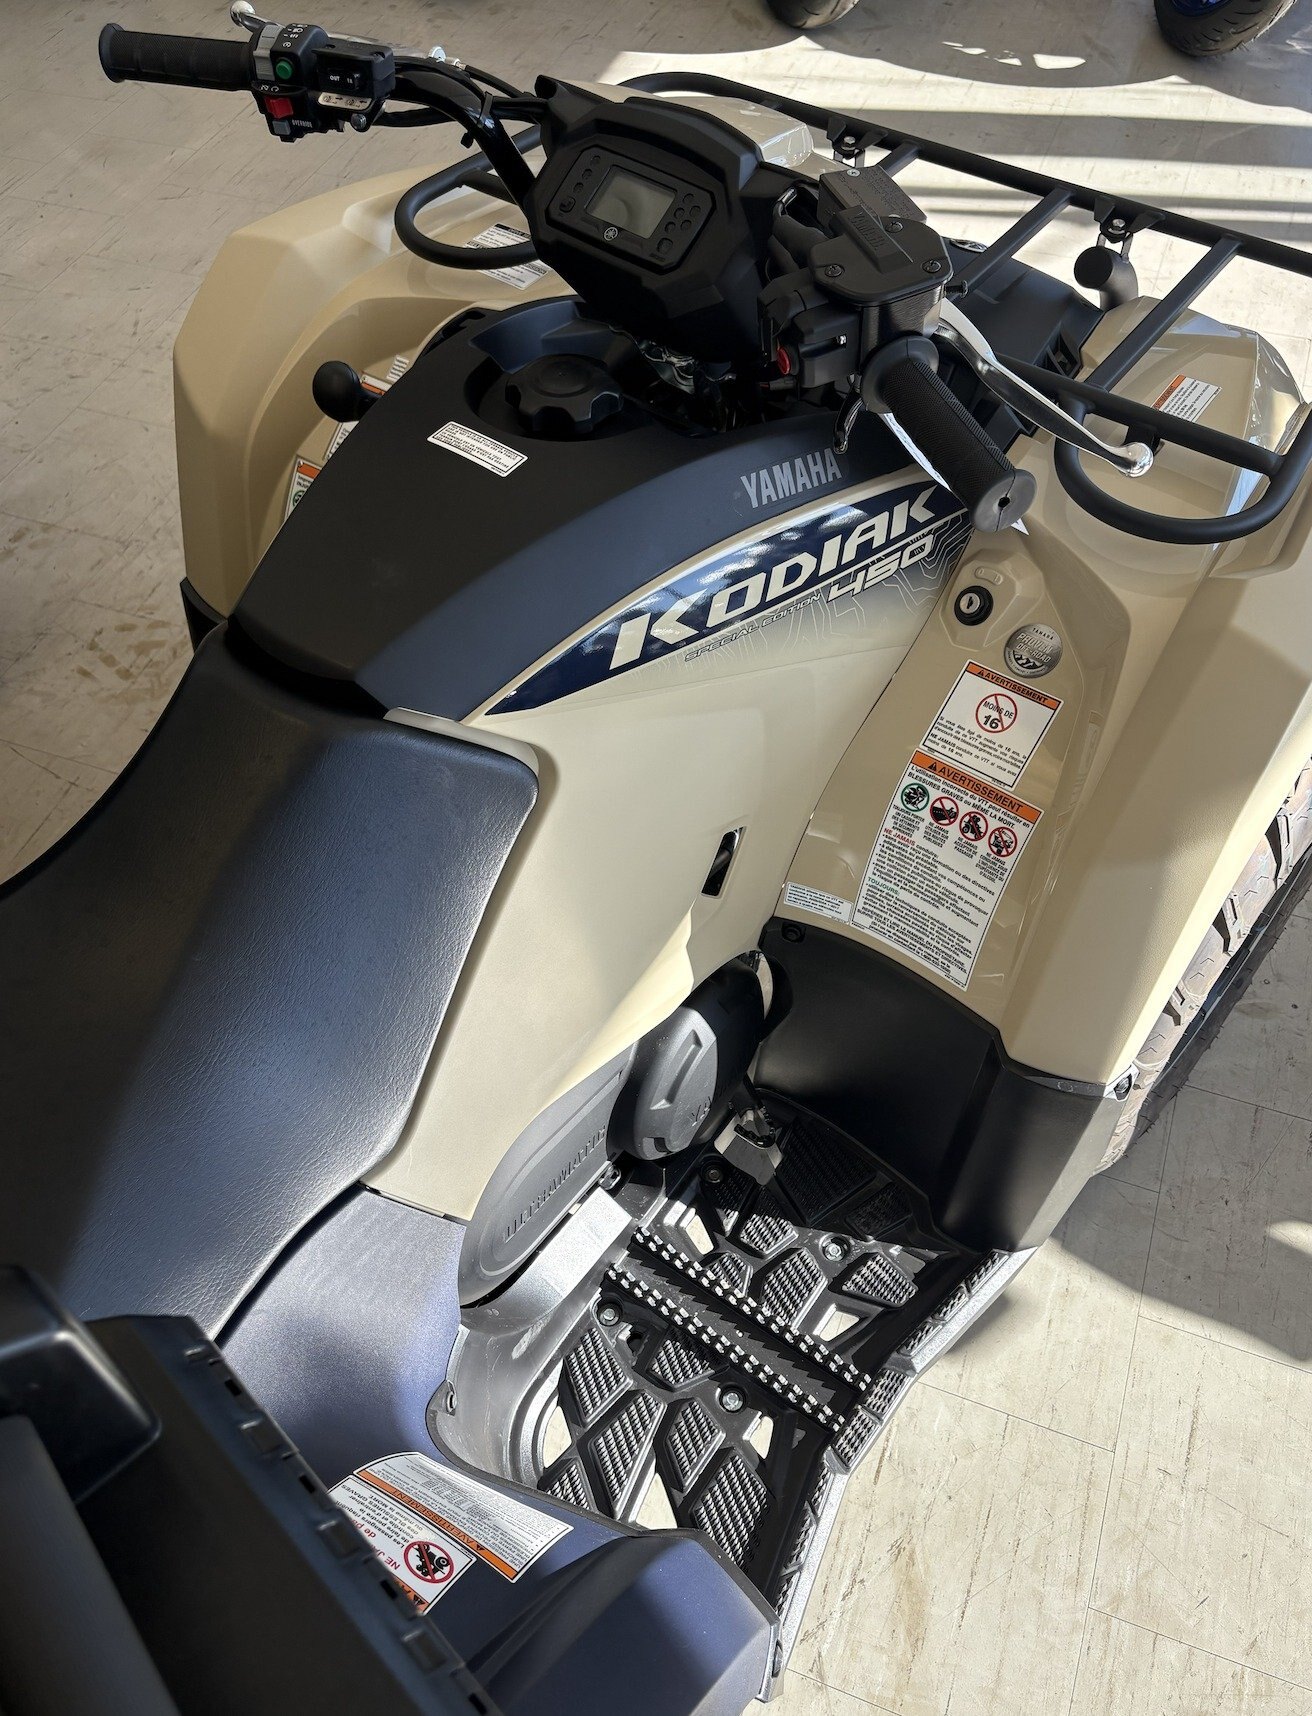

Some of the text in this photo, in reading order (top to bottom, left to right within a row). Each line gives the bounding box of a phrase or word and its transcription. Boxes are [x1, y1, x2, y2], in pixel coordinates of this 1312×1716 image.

[291, 119, 313, 129] OVERRIDE
[740, 447, 842, 509] YAMAHA
[609, 485, 938, 671] KODIAK
[828, 534, 936, 603] 450
[684, 593, 822, 662] SPECIAL EDITION
[1032, 627, 1054, 641] YAMAHA
[1016, 643, 1052, 663] OFF-ROAD
[984, 672, 1048, 703] AVERTISSEMENT
[982, 700, 1014, 719] MOINS DE
[980, 713, 1001, 730] 16
[937, 735, 956, 748] JAMAIS
[983, 737, 996, 745] moins
[910, 764, 1030, 828] L'utilisation incorrecte du VTT peut résulter en
[937, 765, 1024, 813] AVERTISSEMENT
[907, 770, 940, 791] BLESSURES
[940, 786, 964, 802] GRAVES
[971, 801, 989, 815] MÊME
[988, 811, 997, 819] LA
[997, 815, 1015, 829] MORT.
[884, 827, 892, 835] NE
[892, 831, 915, 847] JAMAIS
[866, 874, 900, 897] TOUJOURS:
[340, 1482, 368, 1502] GRAVES
[365, 1511, 387, 1527] perdre
[367, 1499, 406, 1527] BLESSURES
[391, 1490, 475, 1544] AVERTISSEMENT
[393, 1510, 414, 1525] même
[360, 1515, 393, 1539] passagers
[361, 1527, 377, 1539] de
[384, 1525, 401, 1537] faire
[387, 1520, 414, 1539] contrôle
[405, 1525, 419, 1535] des
[391, 1538, 404, 1548] Les
[383, 1556, 400, 1570] NE
